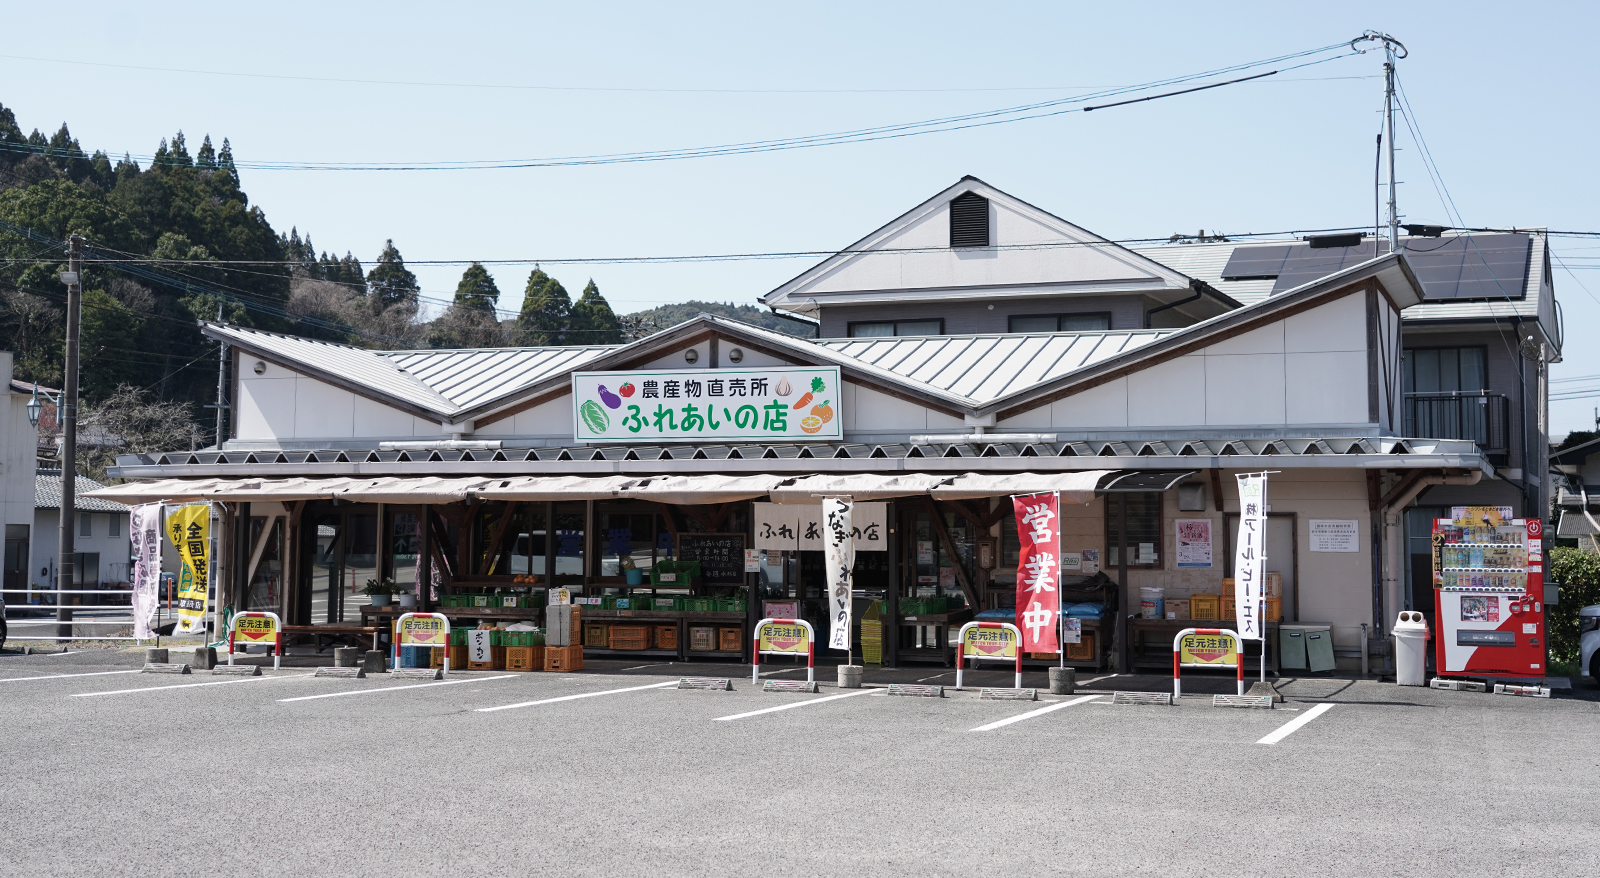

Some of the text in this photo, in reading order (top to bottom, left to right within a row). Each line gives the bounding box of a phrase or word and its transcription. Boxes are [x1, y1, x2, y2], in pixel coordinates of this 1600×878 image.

[642, 377, 768, 398] 農産物直売所
[621, 399, 788, 432] ふれあいの店
[760, 521, 880, 540] ふれあの店
[187, 522, 207, 593] 全国発送
[1022, 503, 1055, 644] 営業中
[239, 620, 274, 629] 足元注意!
[764, 627, 805, 637] 足元注意!
[475, 631, 484, 660] ポンカン
[1184, 638, 1233, 648] 足元注意!
